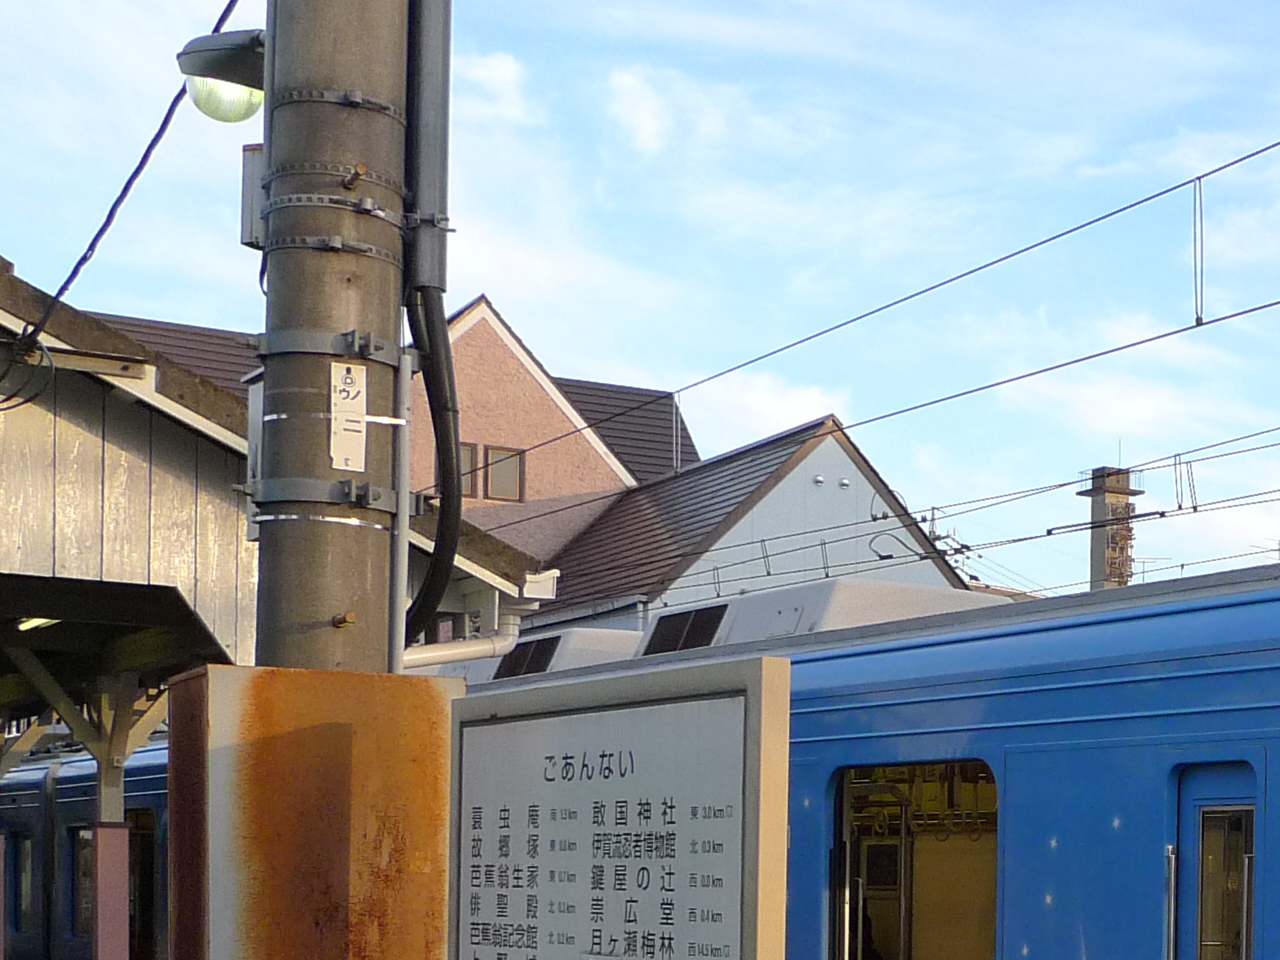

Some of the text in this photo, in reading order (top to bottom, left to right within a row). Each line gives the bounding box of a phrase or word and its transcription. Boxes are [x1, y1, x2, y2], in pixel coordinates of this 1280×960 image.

[544, 750, 635, 782] ごあんない
[592, 797, 676, 827] 敢国神社
[470, 864, 540, 890] 芭蕉翁生家
[591, 864, 675, 892] 鍵屋の辻
[590, 896, 675, 926] 崇広堂
[470, 922, 538, 950] 芭蕉翁記念館
